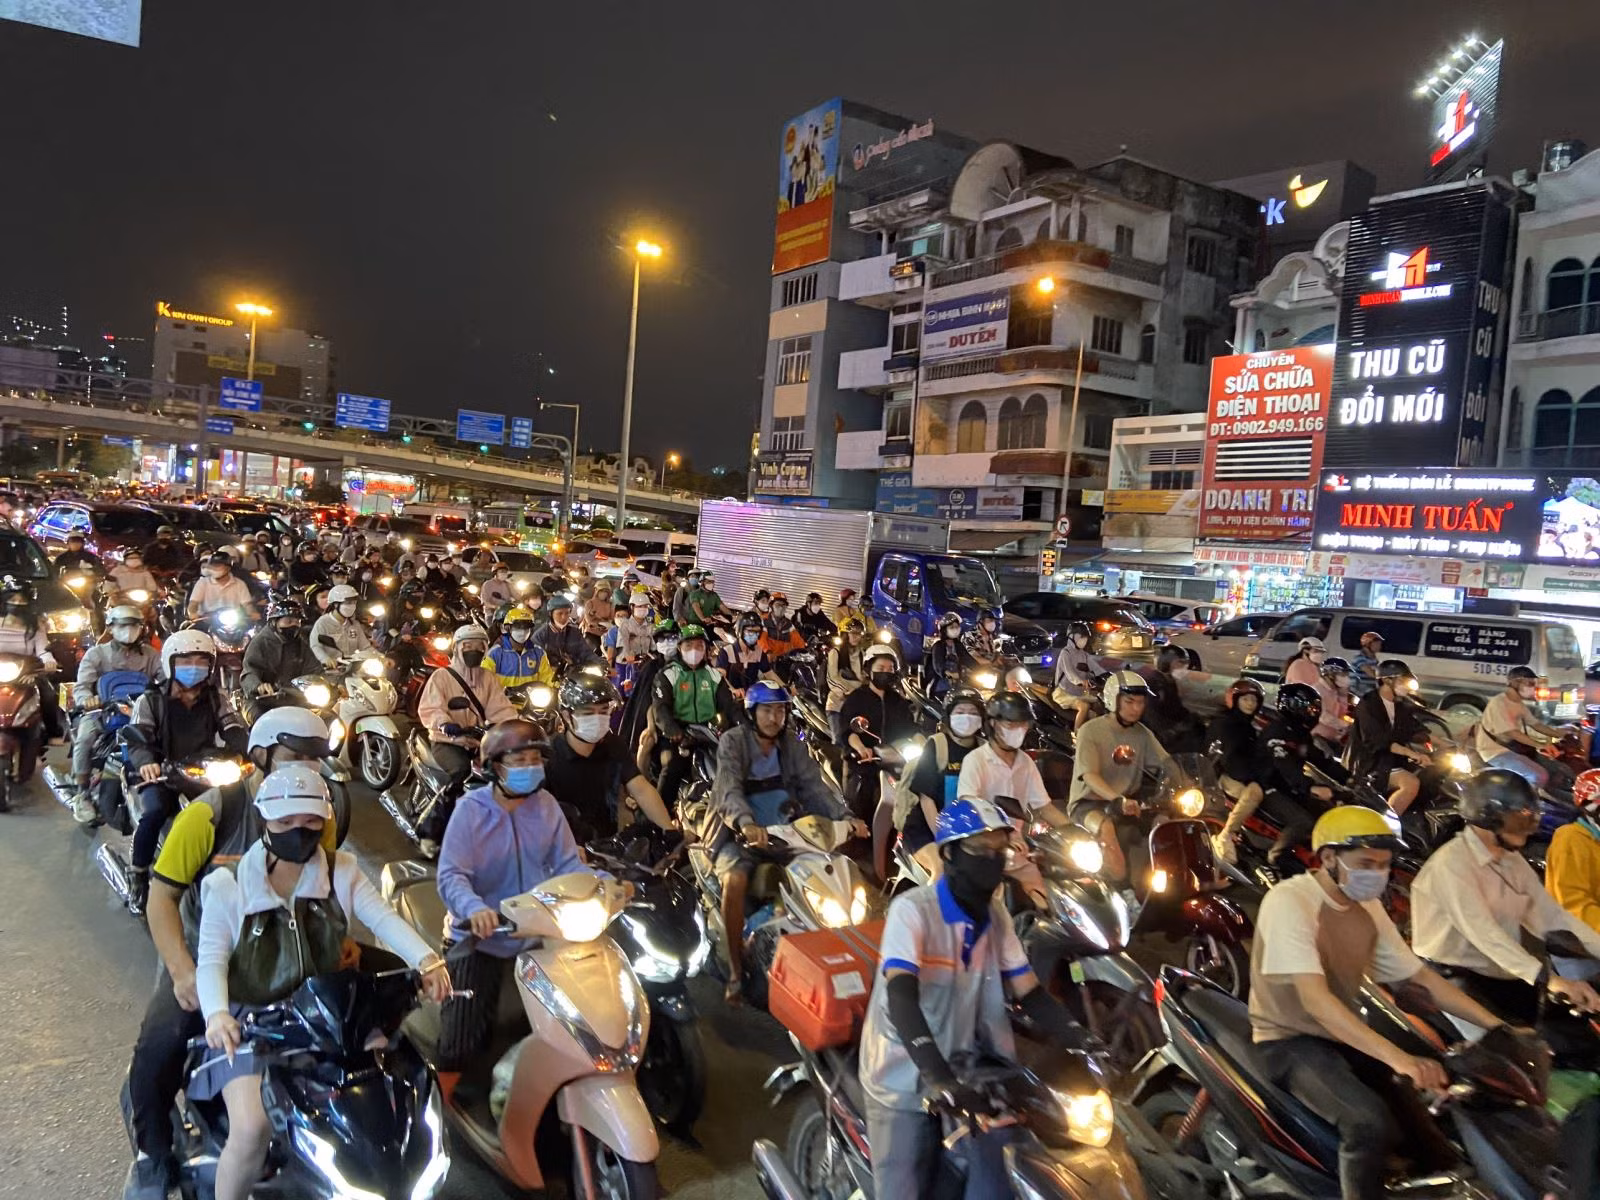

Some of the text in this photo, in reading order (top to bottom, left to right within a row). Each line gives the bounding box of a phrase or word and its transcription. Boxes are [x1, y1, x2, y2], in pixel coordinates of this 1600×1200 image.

[1479, 280, 1500, 314] THU
[208, 316, 234, 327] GROUP
[1246, 353, 1295, 369] CHUYÊN
[1350, 339, 1446, 378] THU CŨ
[1224, 365, 1315, 394] SỬA CHỮA
[1216, 392, 1321, 420] ĐIỆN THOẠI
[1340, 385, 1445, 425] ĐỔI MỚI
[1205, 489, 1272, 511] DOANH
[1341, 498, 1505, 532] MINH TUẤN
